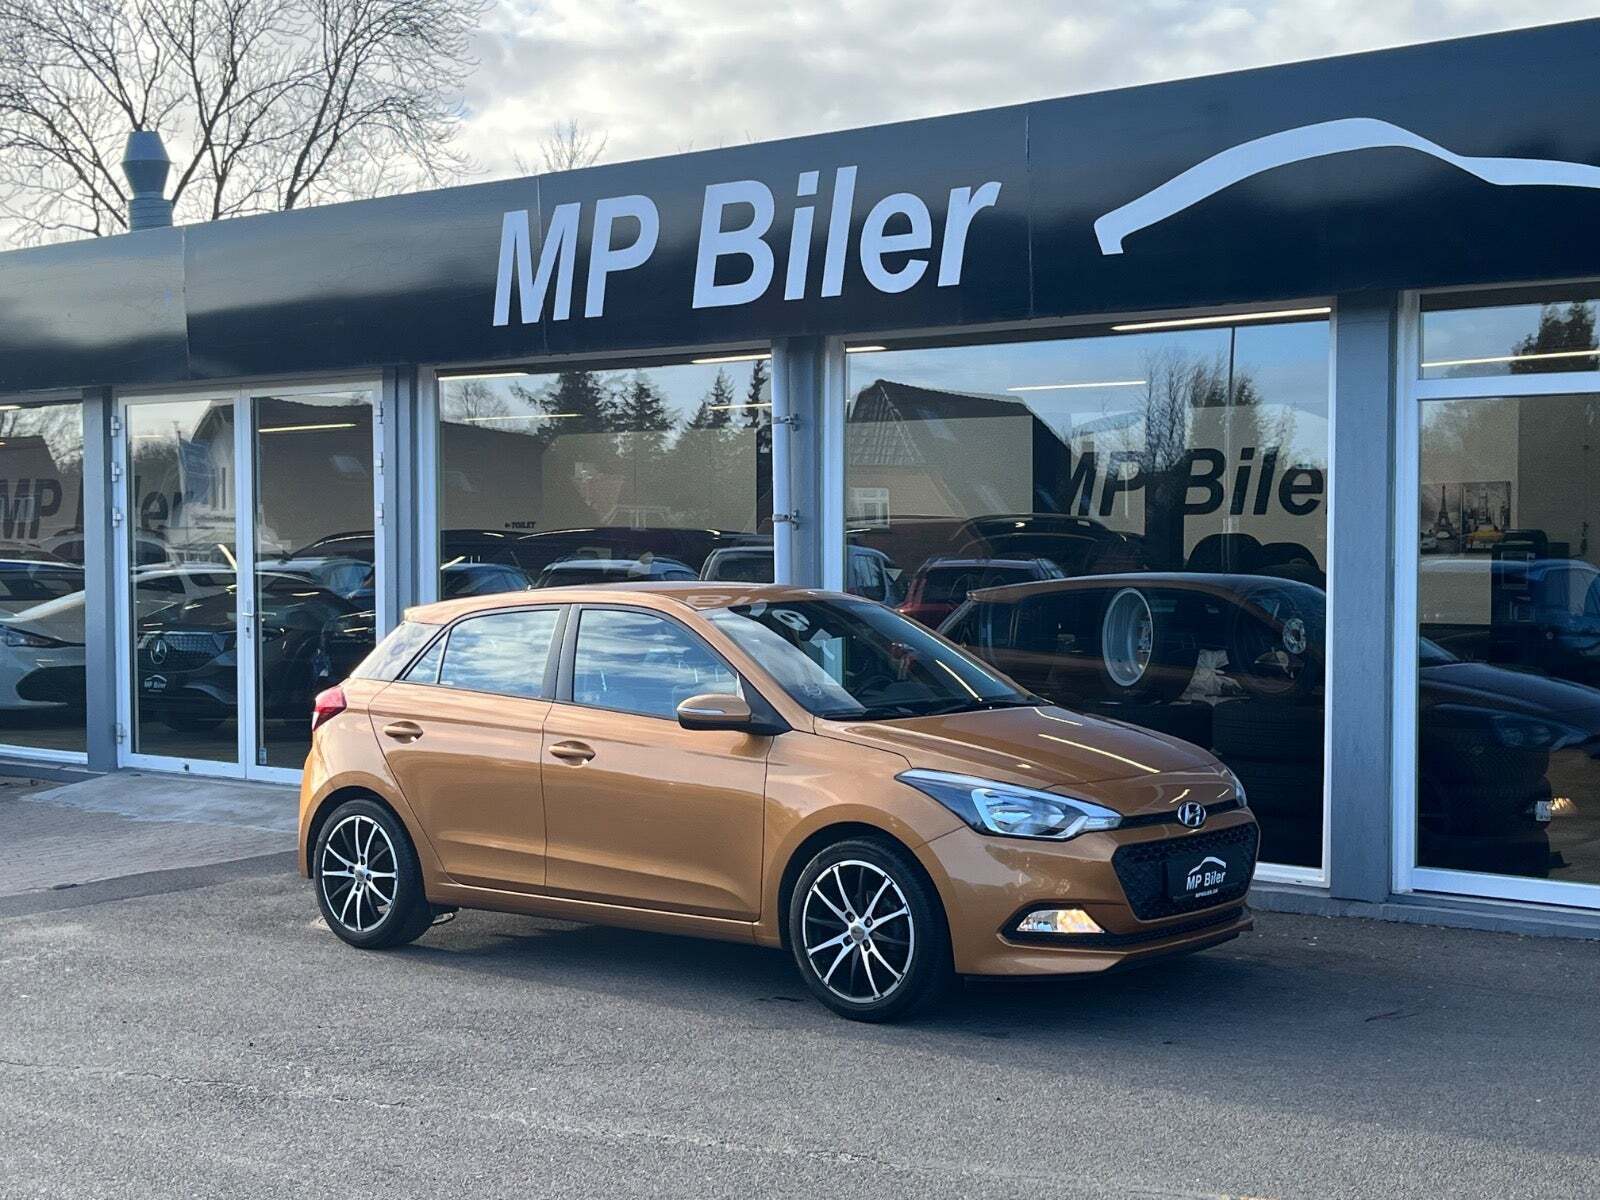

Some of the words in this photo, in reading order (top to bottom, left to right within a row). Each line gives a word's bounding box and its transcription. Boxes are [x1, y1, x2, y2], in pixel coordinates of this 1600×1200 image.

[493, 195, 660, 327] MP
[692, 165, 1003, 309] Biler
[1172, 447, 1327, 517] Bile
[1186, 874, 1202, 891] MP
[1204, 871, 1226, 886] Biler
